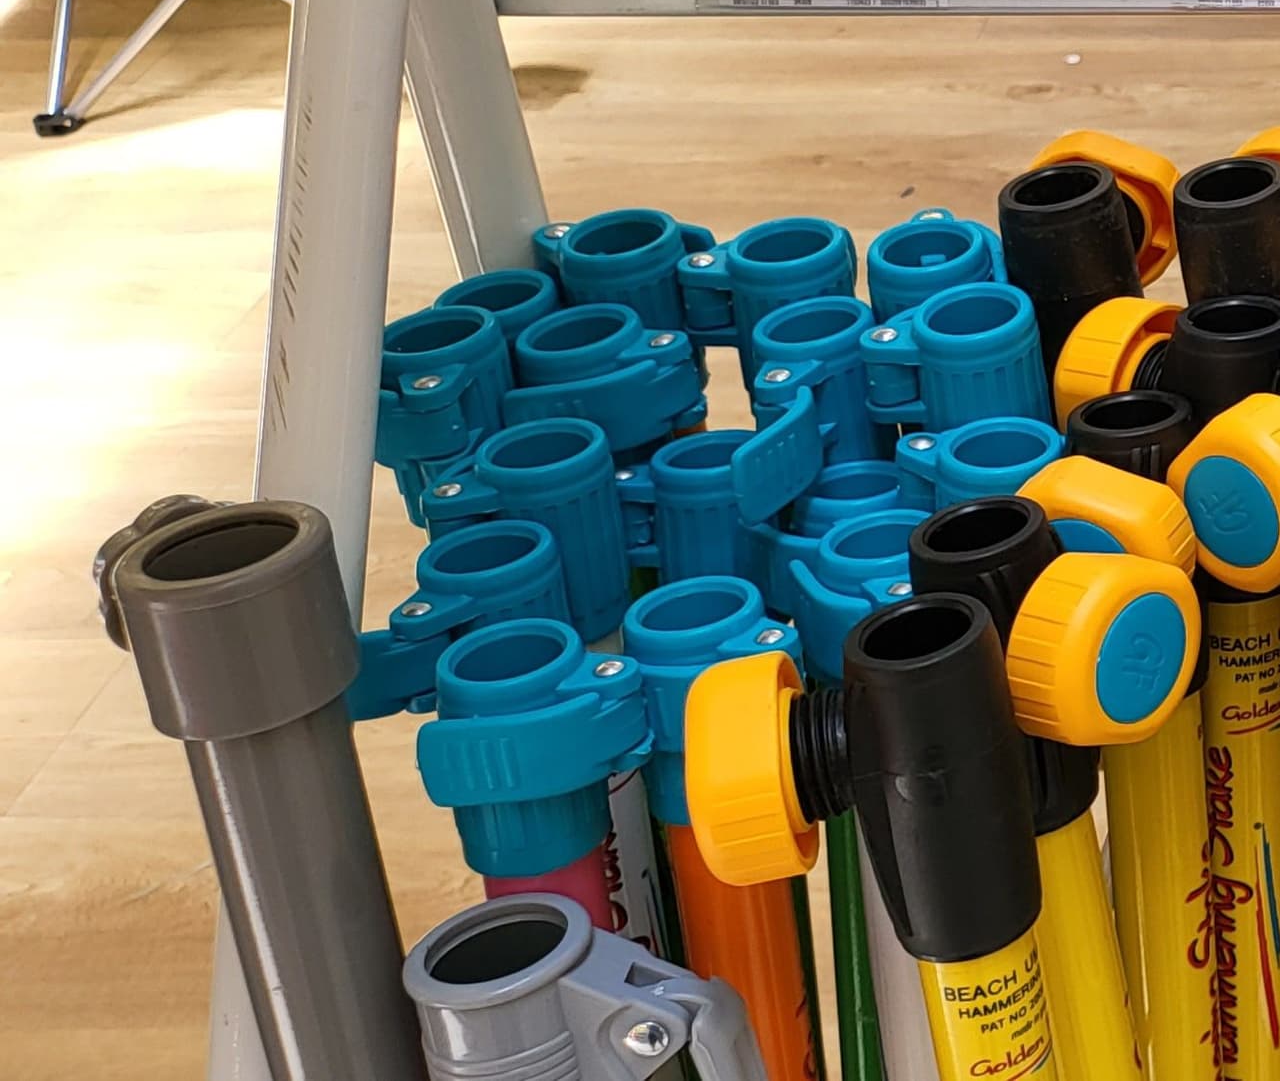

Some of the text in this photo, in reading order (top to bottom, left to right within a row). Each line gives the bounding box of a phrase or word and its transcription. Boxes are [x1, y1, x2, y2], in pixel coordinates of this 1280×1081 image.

[1208, 632, 1271, 652] BEACH
[1235, 667, 1275, 683] PAT NO
[944, 969, 1018, 1002] BEACH
[981, 1006, 1027, 1034] PAT NO
[970, 1036, 1044, 1077] Golden
